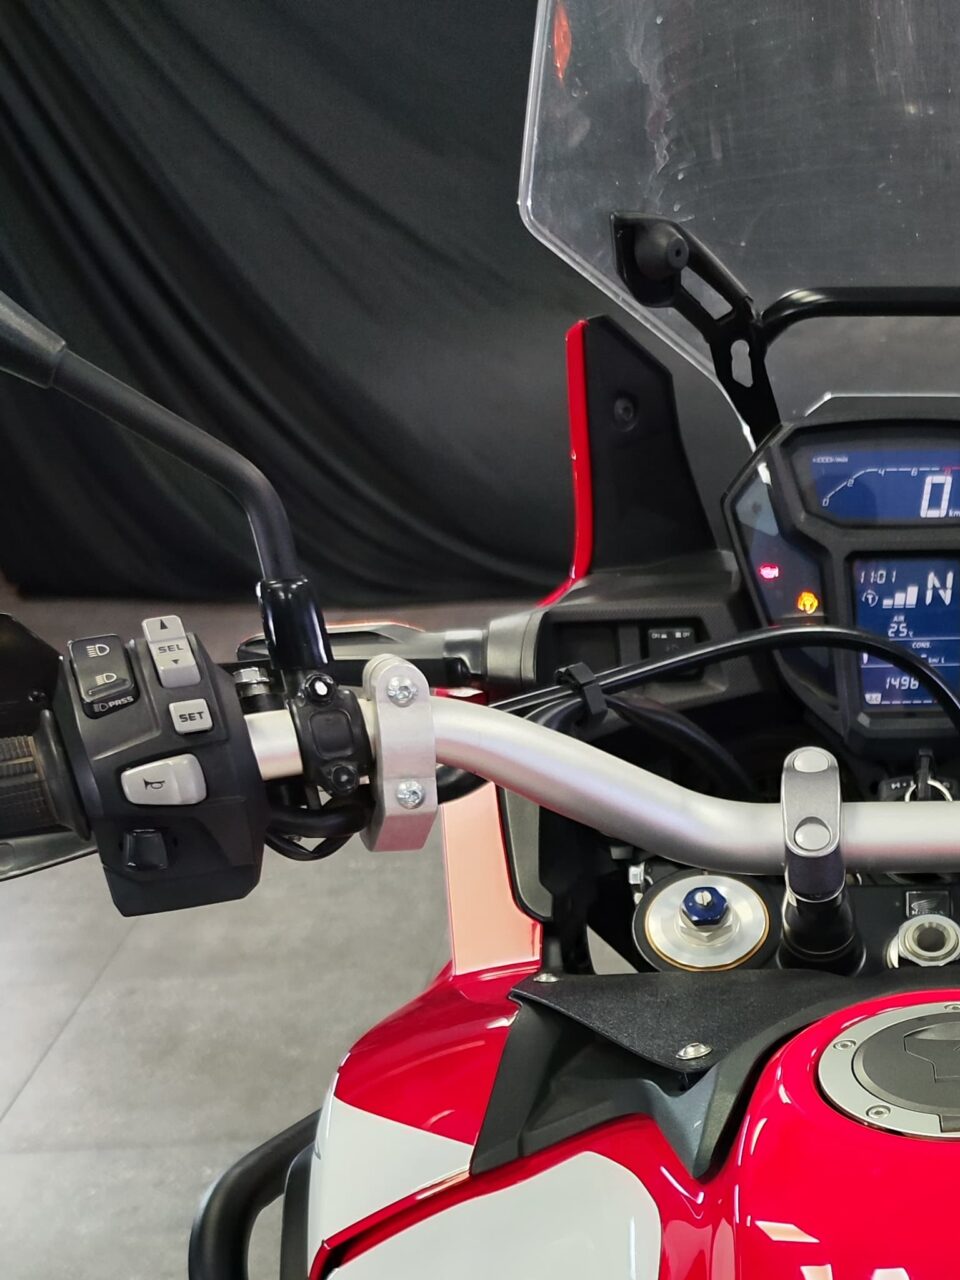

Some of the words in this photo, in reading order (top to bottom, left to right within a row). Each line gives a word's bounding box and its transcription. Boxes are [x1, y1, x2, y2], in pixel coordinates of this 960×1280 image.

[920, 475, 952, 518] 0
[925, 571, 954, 606] N
[158, 644, 184, 654] SEL
[108, 696, 134, 708] PASS
[178, 711, 204, 723] SET
